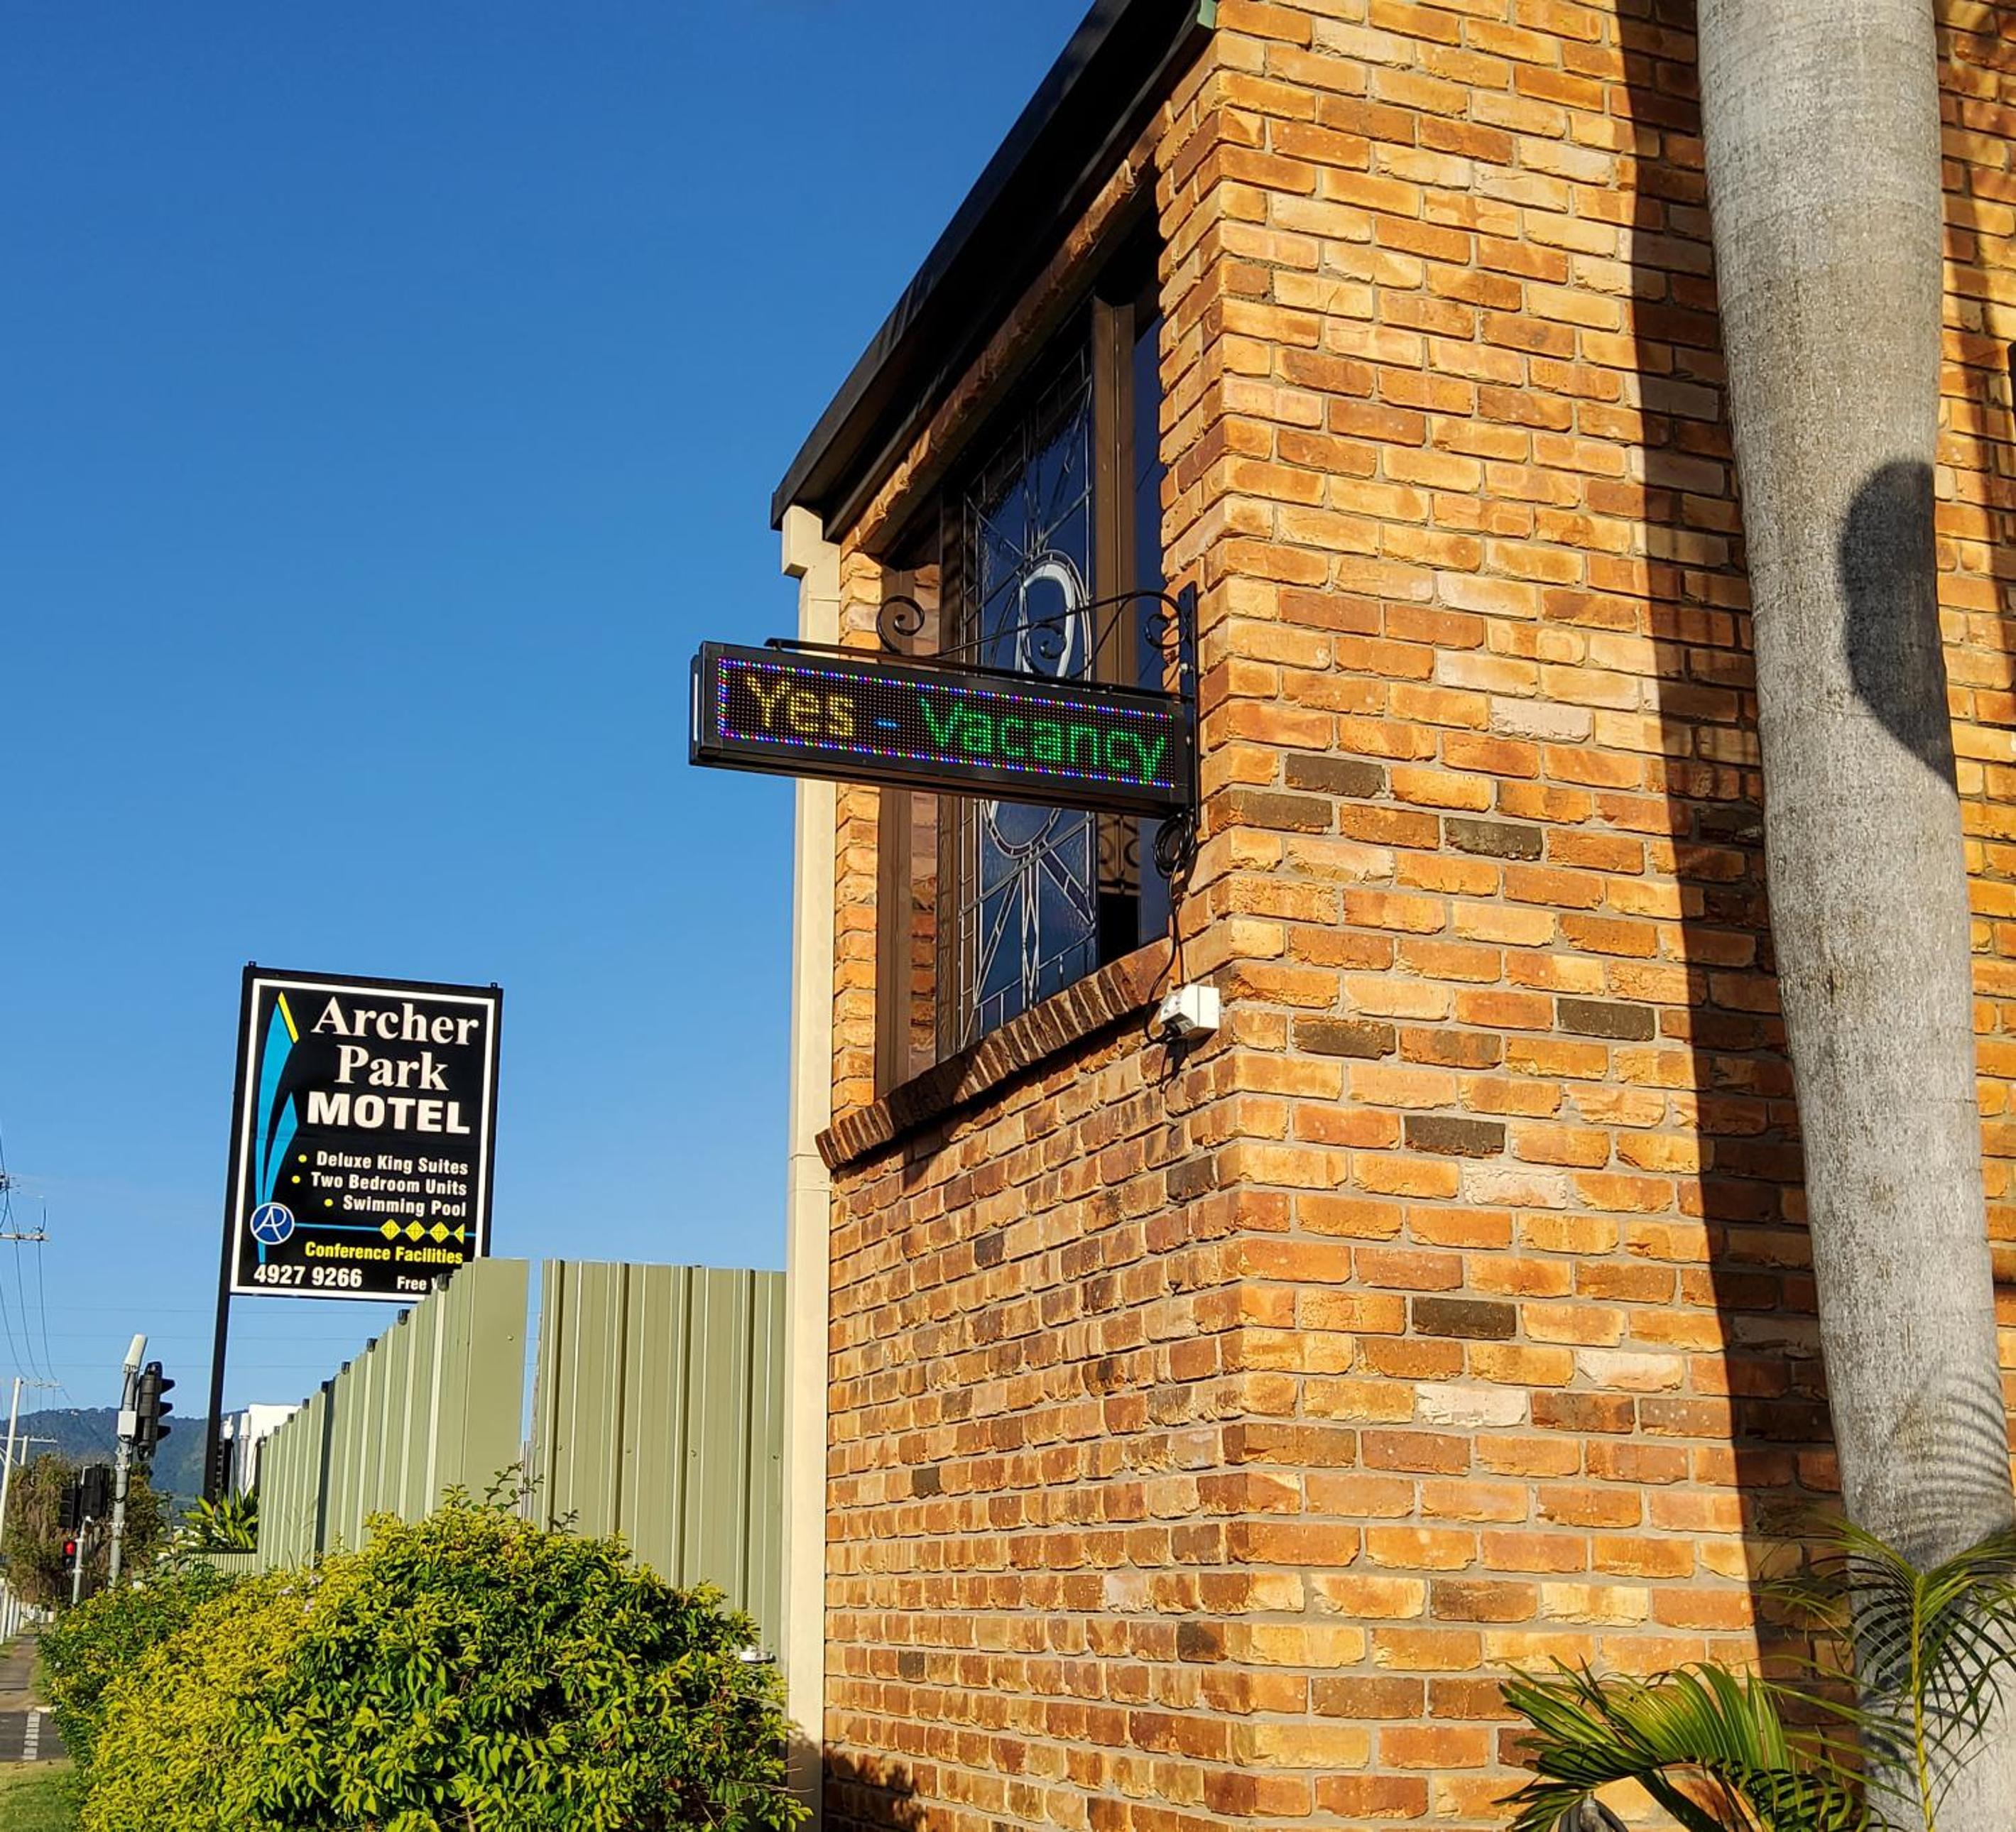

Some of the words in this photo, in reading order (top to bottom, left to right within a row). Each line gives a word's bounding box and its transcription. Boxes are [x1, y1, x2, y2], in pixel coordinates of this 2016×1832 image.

[743, 672, 854, 737] Yes
[920, 697, 1166, 783] Vacancy
[311, 996, 479, 1045] Archer
[334, 1045, 449, 1091] Park
[307, 1091, 470, 1134] MOTEL
[317, 1150, 371, 1169] Deluxe
[377, 1155, 413, 1173] King
[418, 1157, 468, 1175] Suites
[311, 1172, 344, 1189] Two
[349, 1175, 420, 1192] Bedroom
[425, 1179, 467, 1195] Units
[343, 1196, 425, 1216] Swimming
[431, 1201, 466, 1216] Pool
[305, 1242, 390, 1260] Conference
[395, 1246, 463, 1264] Facilities
[254, 1264, 305, 1285] 4927
[311, 1267, 362, 1287] 9266
[397, 1276, 427, 1290] Free
